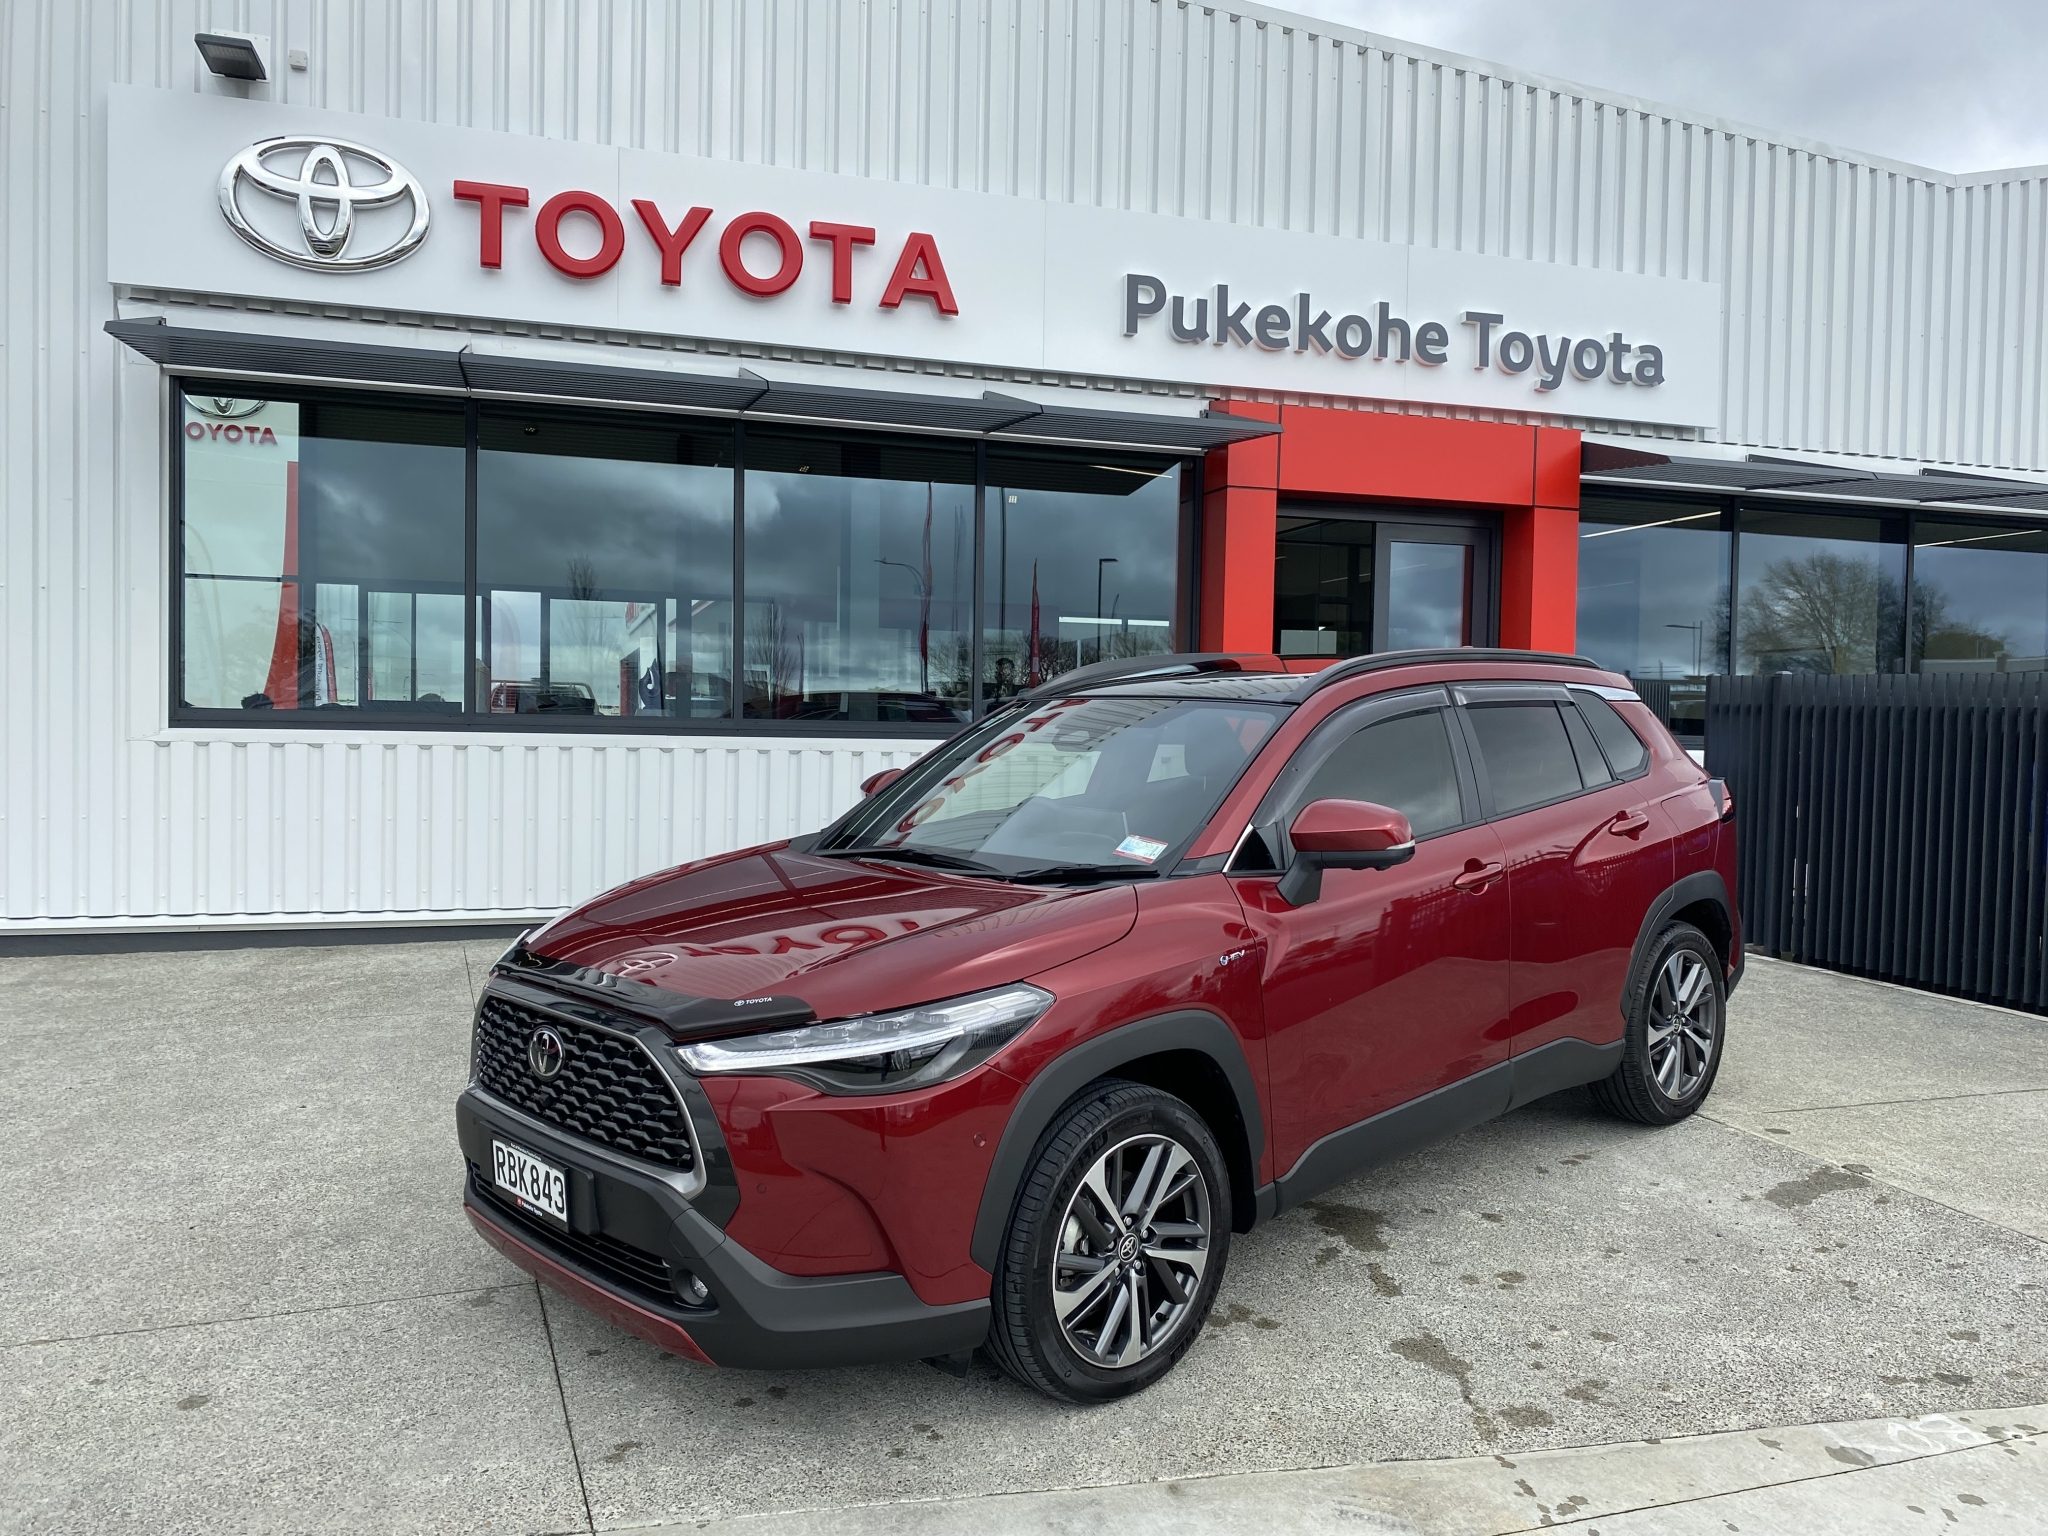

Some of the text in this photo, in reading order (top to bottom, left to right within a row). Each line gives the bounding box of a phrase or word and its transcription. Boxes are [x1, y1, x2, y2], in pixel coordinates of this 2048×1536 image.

[453, 179, 960, 317] TOYOTA
[1122, 273, 1665, 392] Pukekohe Toyota
[185, 421, 278, 446] OYOTA
[745, 996, 773, 1006] TOYOTA
[495, 1145, 566, 1215] RBK843
